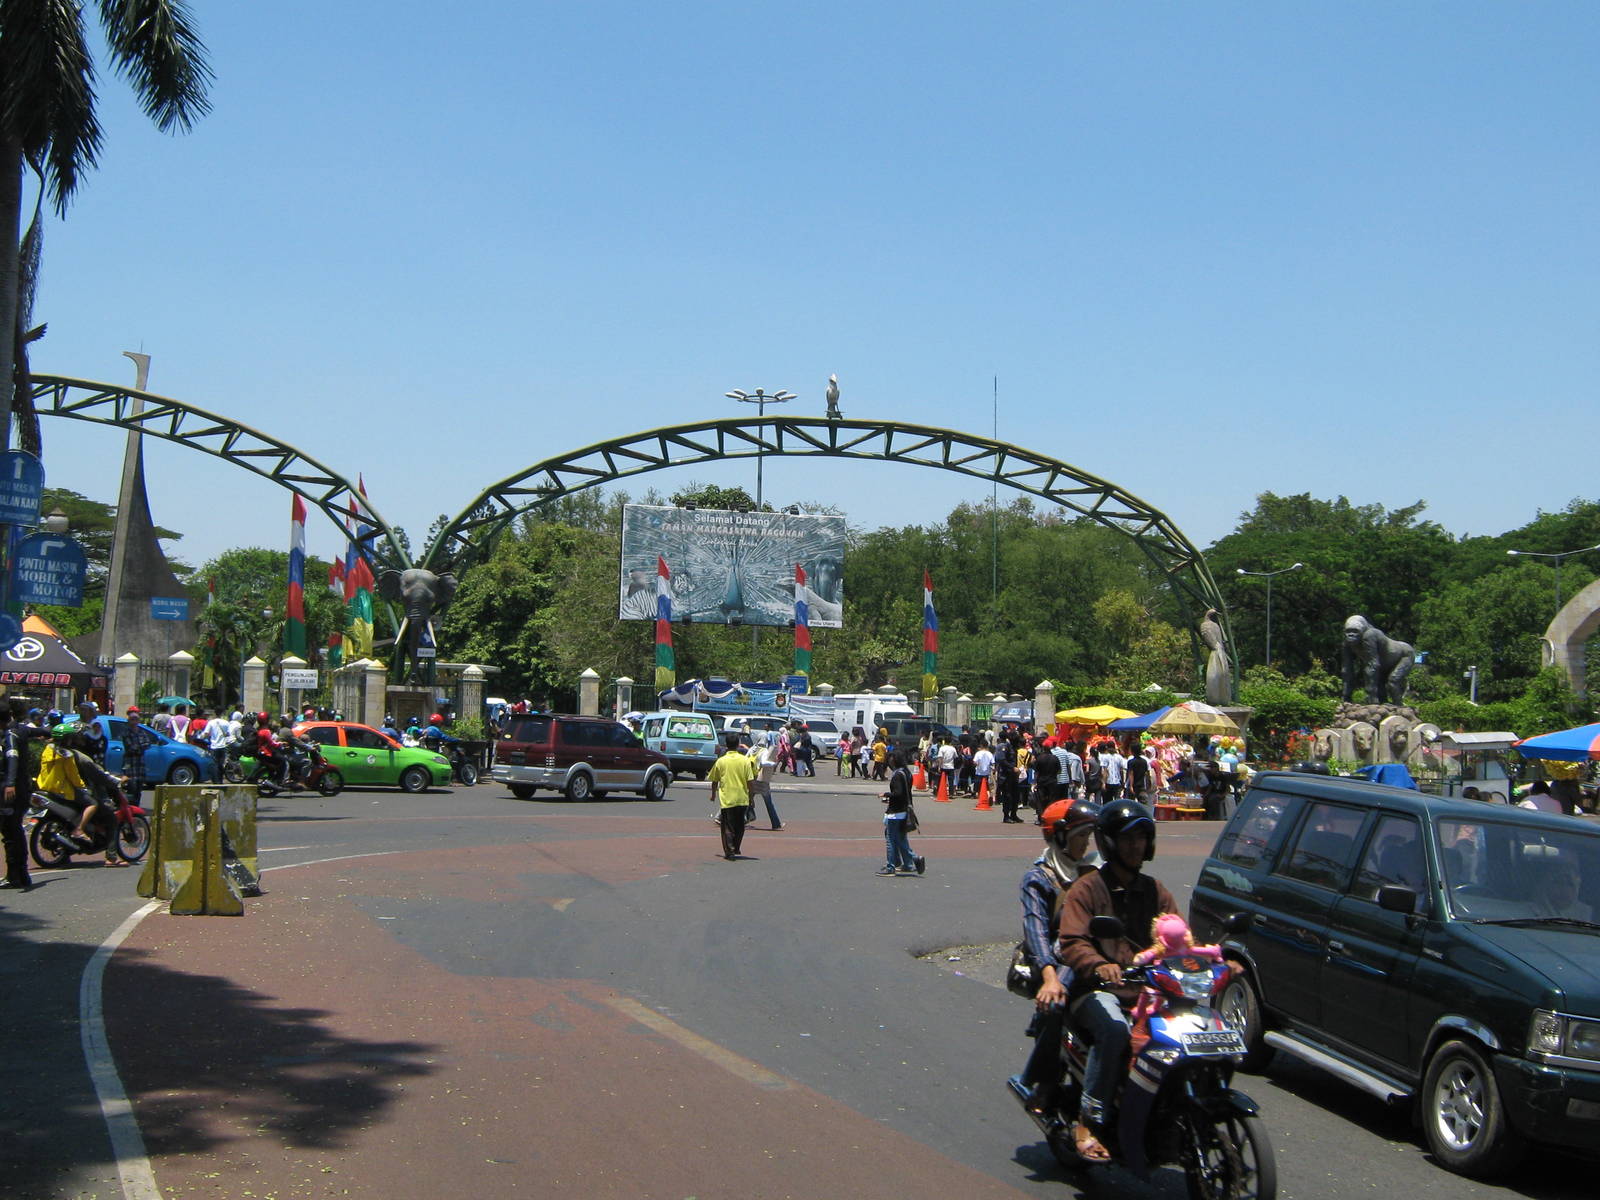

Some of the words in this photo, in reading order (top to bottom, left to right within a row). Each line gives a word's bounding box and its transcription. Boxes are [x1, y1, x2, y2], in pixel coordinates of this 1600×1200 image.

[661, 522, 693, 533] TAMAN
[694, 513, 733, 525] Selamat
[736, 515, 770, 528] Datang
[18, 557, 46, 570] PINTU
[47, 560, 79, 574] MASUK
[17, 570, 60, 585] MOBIL
[62, 574, 73, 585] &
[32, 583, 78, 599] MOTOR
